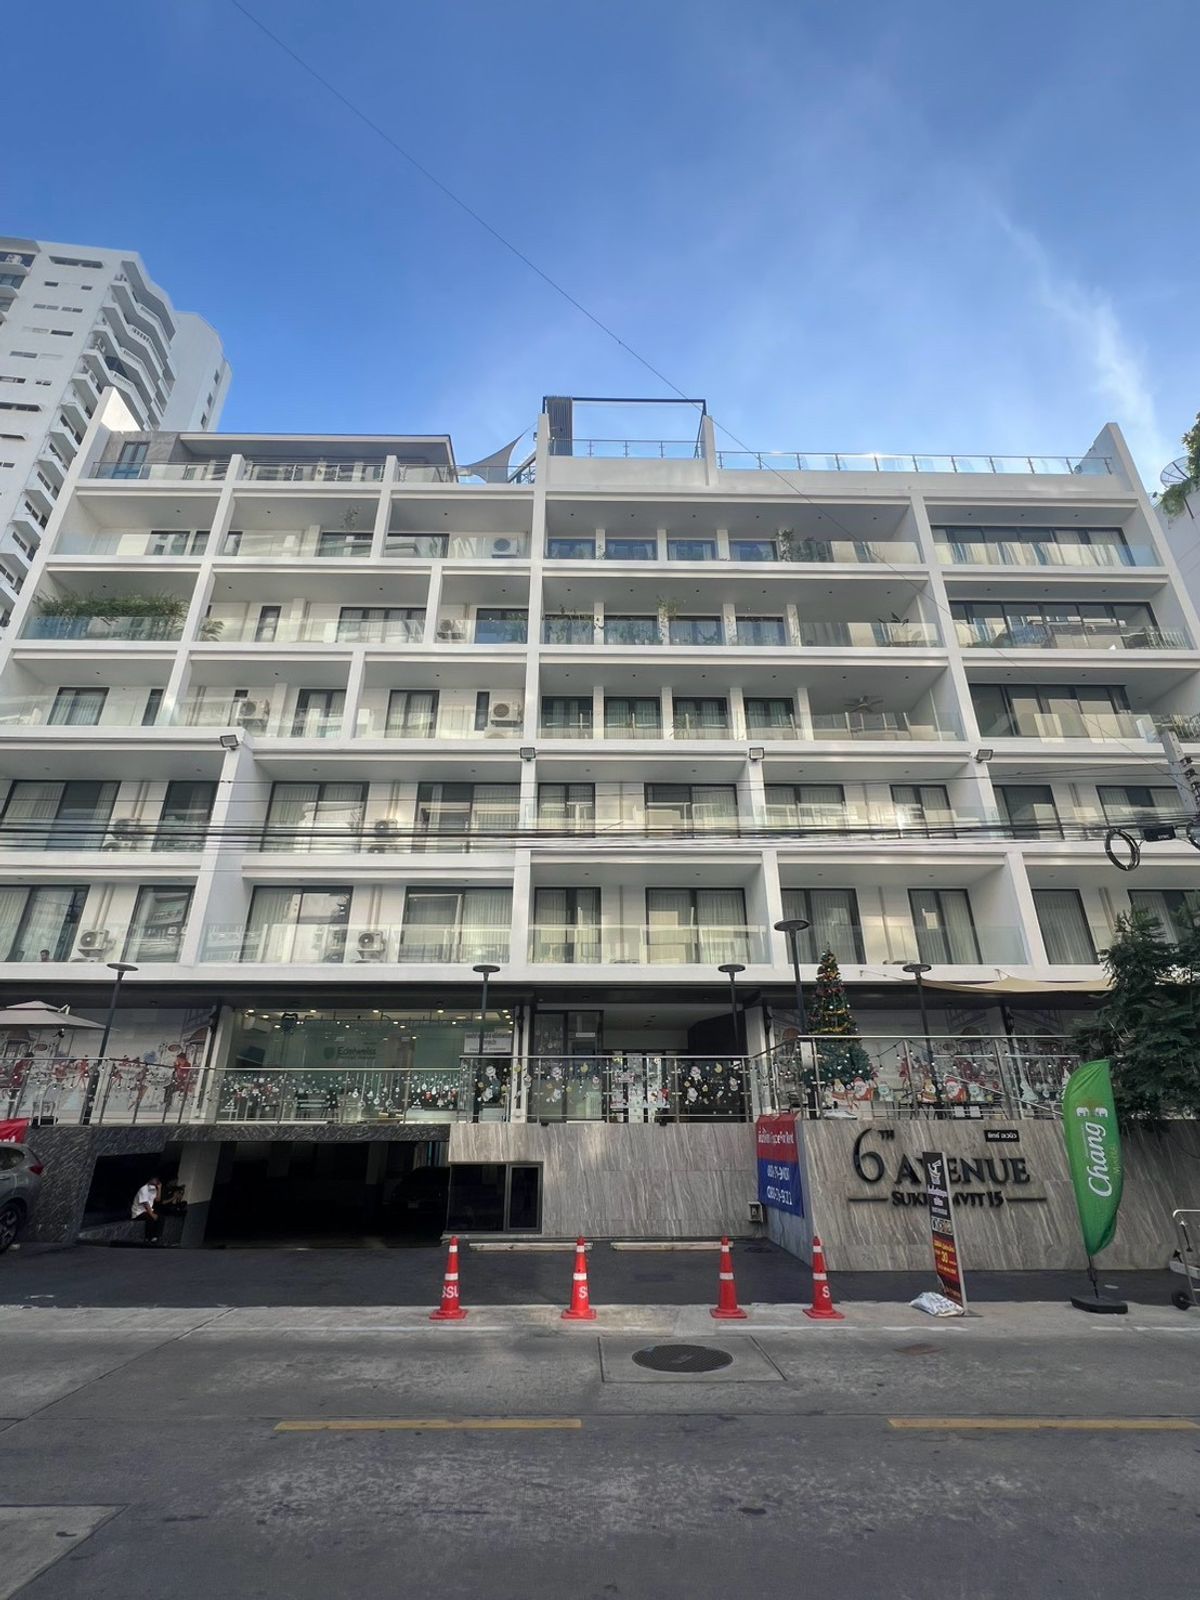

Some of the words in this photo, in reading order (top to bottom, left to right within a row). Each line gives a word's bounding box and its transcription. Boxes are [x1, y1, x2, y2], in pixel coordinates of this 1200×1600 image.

[894, 1155, 1031, 1185] AENUE
[1086, 1121, 1113, 1197] Chang
[988, 1190, 1004, 1208] 15
